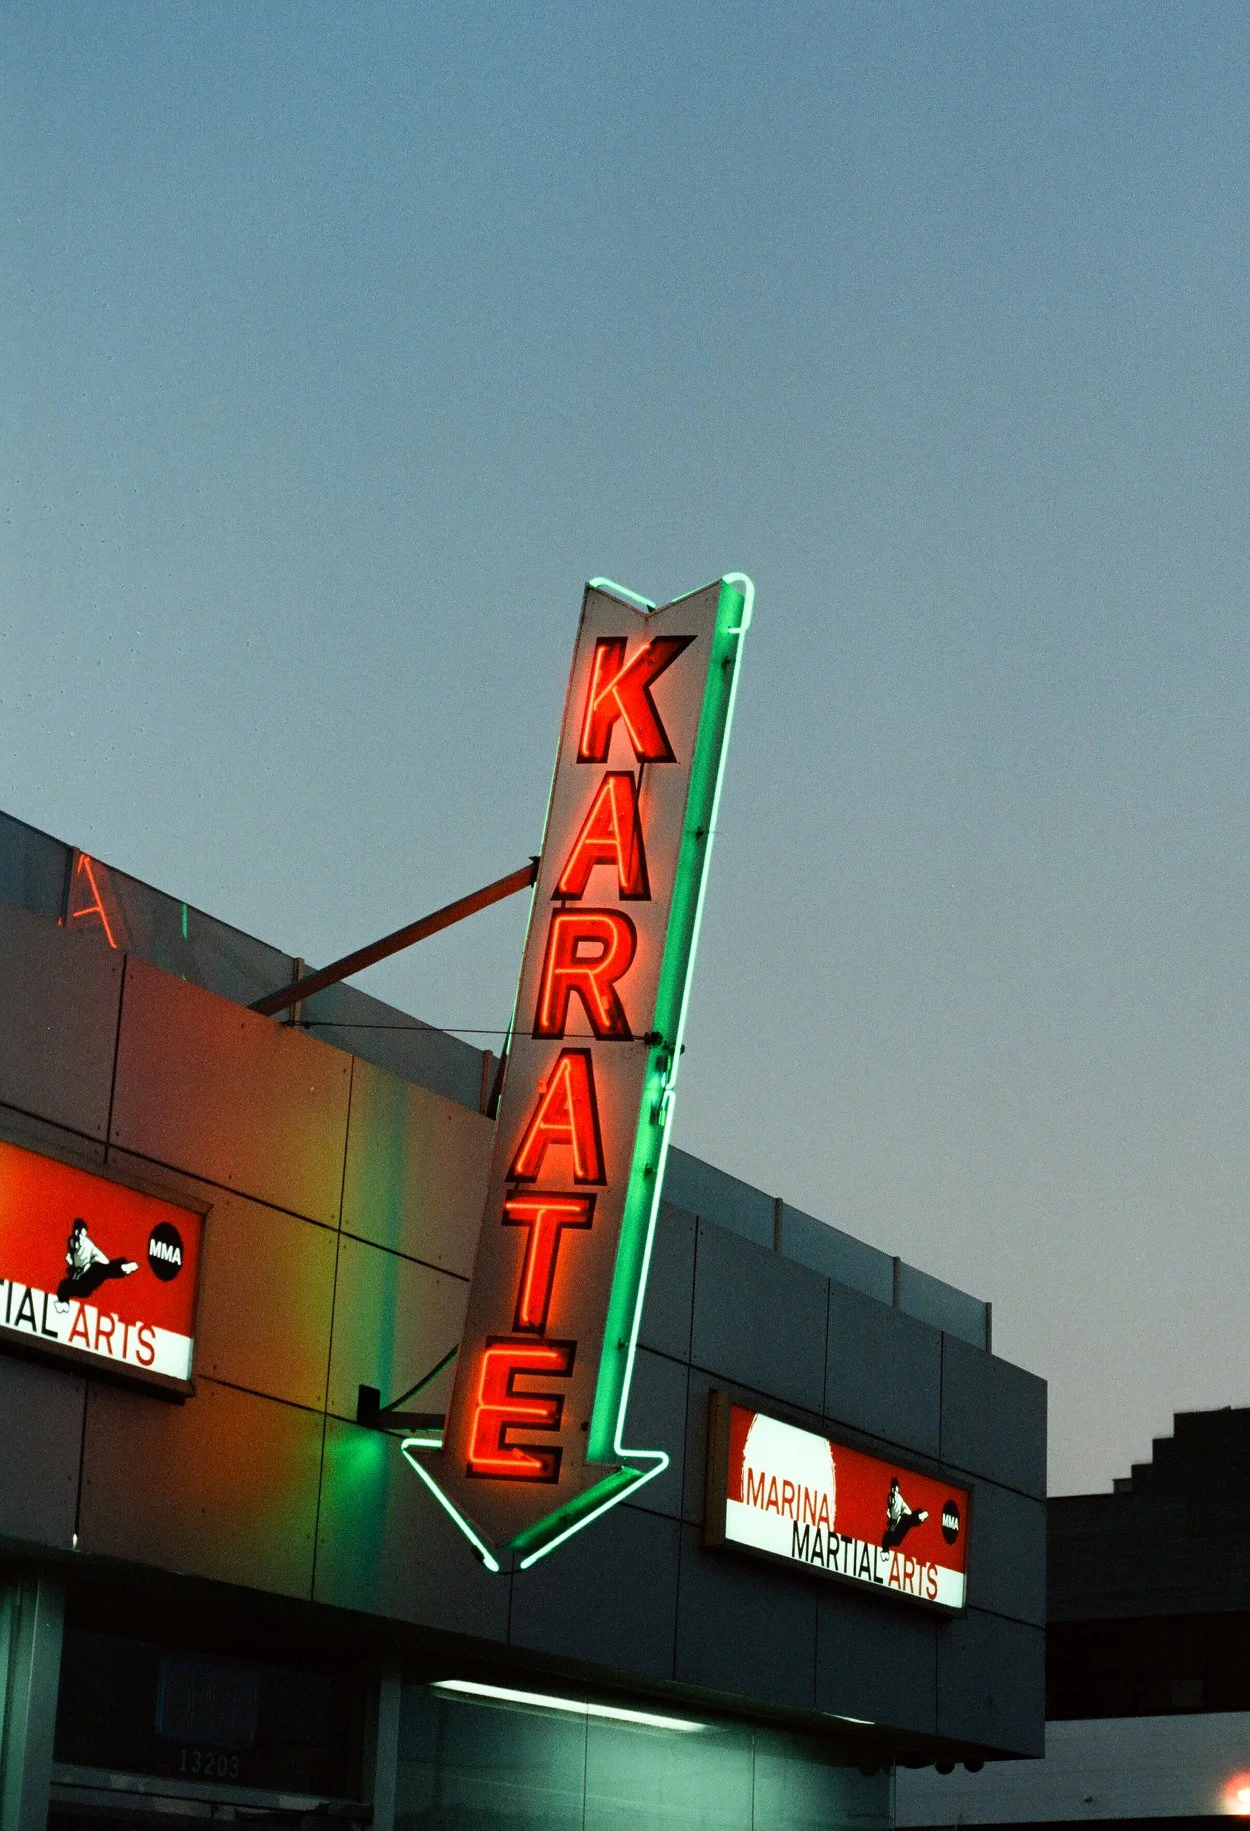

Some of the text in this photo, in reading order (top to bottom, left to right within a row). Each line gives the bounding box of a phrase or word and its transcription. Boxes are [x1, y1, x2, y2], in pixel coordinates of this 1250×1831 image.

[464, 635, 697, 1485] KARATE
[149, 1238, 182, 1266] MMA
[68, 1302, 156, 1366] ARTS
[746, 1467, 831, 1532] MARINA
[942, 1512, 959, 1531] MMA
[792, 1520, 938, 1600] MARTIAL ARTS
[179, 1748, 240, 1778] 13203
